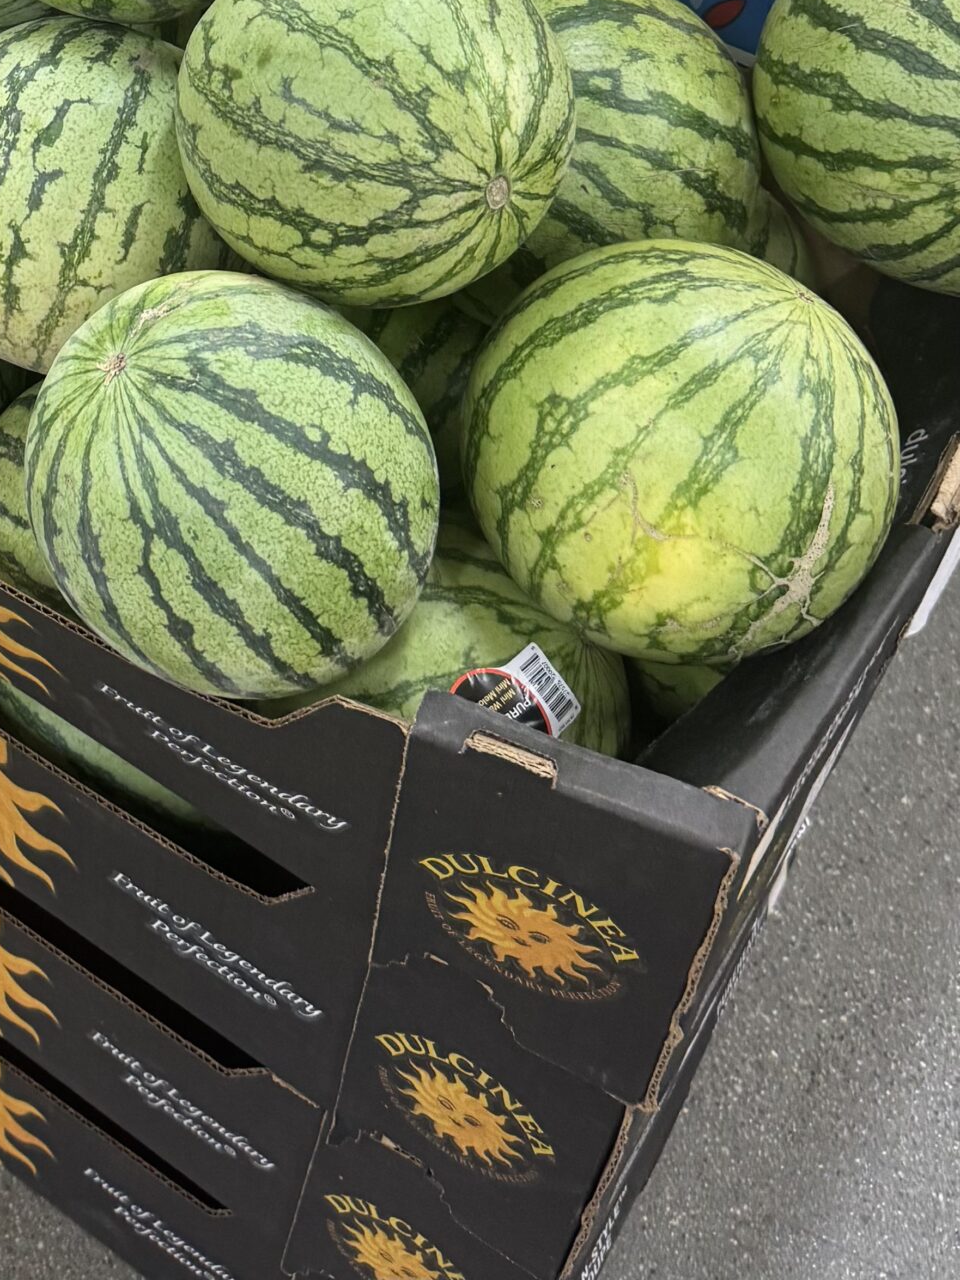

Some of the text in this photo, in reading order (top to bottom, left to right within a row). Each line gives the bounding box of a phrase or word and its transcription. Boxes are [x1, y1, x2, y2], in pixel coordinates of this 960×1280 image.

[100, 683, 348, 830] Fruit of Legendary
[113, 872, 323, 1018] Fruit of Legendary
[419, 853, 640, 964] DULCINEA
[92, 1031, 275, 1169] Fruit of Legendary
[374, 1031, 555, 1156] DULCINEA
[324, 1193, 466, 1280] DULCINE
